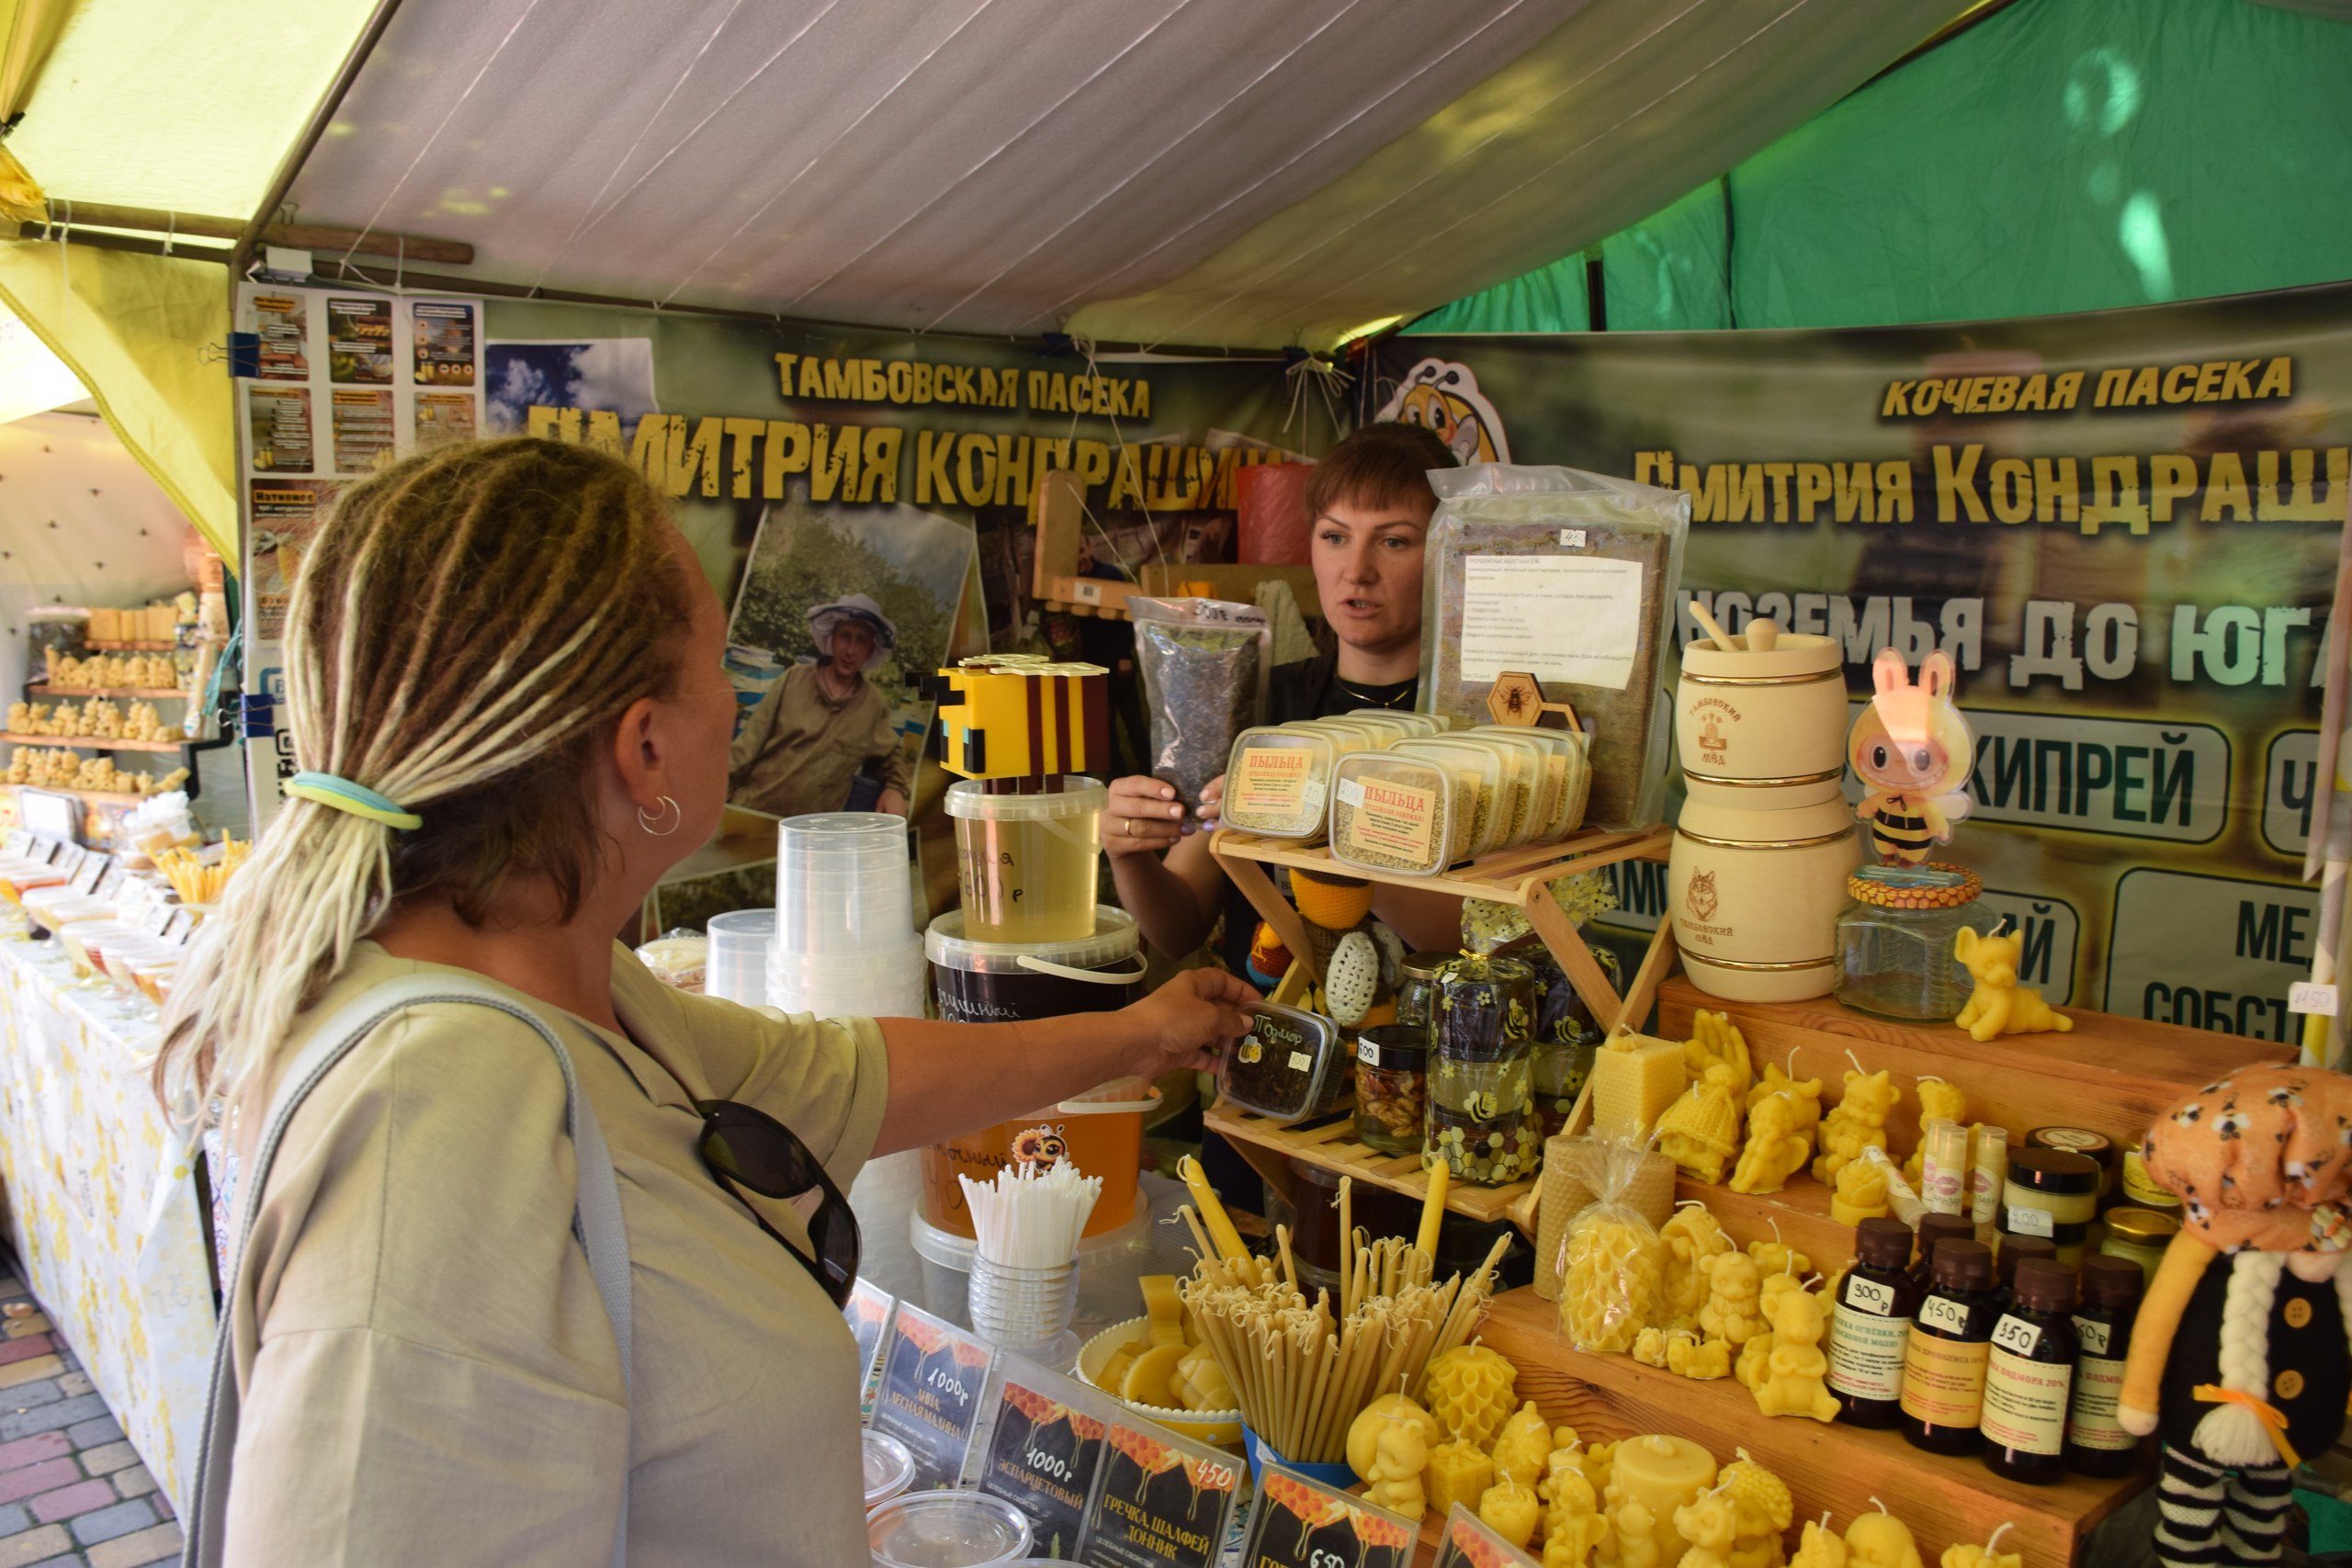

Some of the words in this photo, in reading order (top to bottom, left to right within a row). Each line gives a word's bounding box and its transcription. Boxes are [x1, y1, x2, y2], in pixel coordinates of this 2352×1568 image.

[775, 353, 1018, 408] ТАМБОВСКАЯ
[1028, 371, 1150, 418] ПАСЕКА
[1882, 372, 2085, 416] КОЧЕВАЯ
[2094, 356, 2291, 409] ПАСЕКА
[2009, 601, 2138, 691] ДО
[1250, 756, 1303, 771] ПЫЛЬЦА
[1365, 785, 1425, 813] ПЫЛЬЦА
[2235, 900, 2312, 973] МЕ
[2143, 981, 2304, 1046] СОБСТ
[2000, 1366, 2044, 1386] ПОДМОРА
[999, 1459, 1084, 1511] ЭСПАРЦЕТОВЫЙ
[1197, 1459, 1232, 1486] 450
[1103, 1494, 1149, 1529] ГРЕЧКА,
[1151, 1517, 1210, 1555] ШАЛФЕЙ
[1125, 1525, 1178, 1561] ДОННИК
